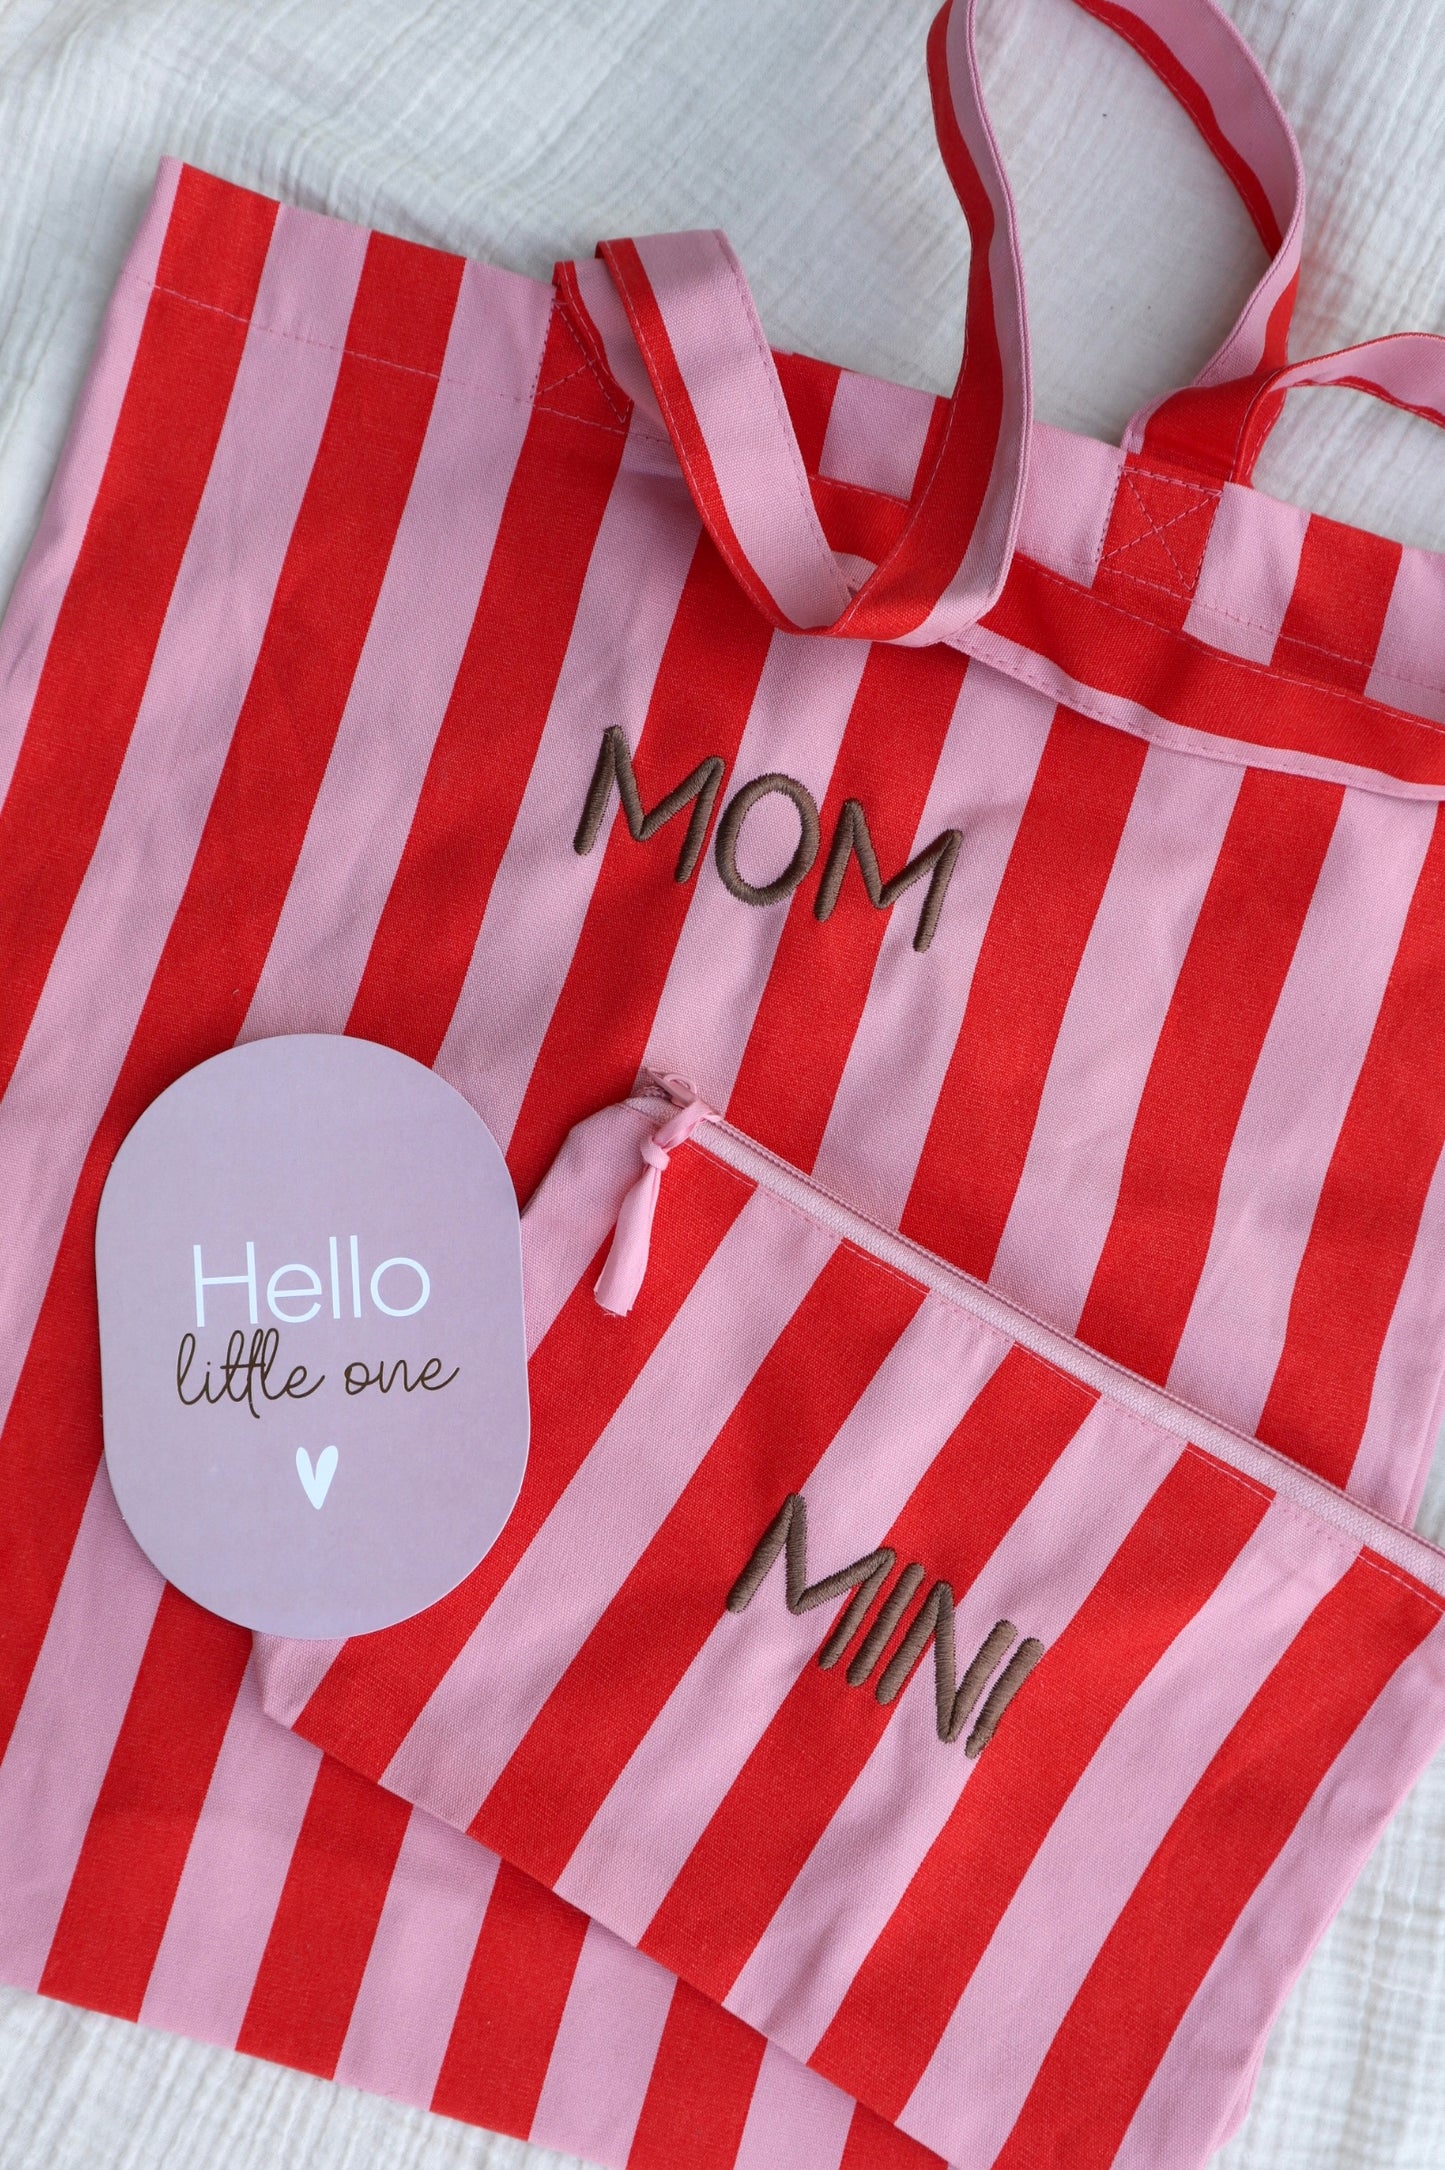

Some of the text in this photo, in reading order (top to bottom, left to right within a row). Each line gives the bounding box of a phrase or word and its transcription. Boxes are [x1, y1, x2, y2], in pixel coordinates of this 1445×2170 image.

[573, 725, 963, 952] MOM
[193, 1235, 430, 1327] Hello
[176, 1328, 460, 1418] little one
[726, 1493, 1044, 1759] MINI
